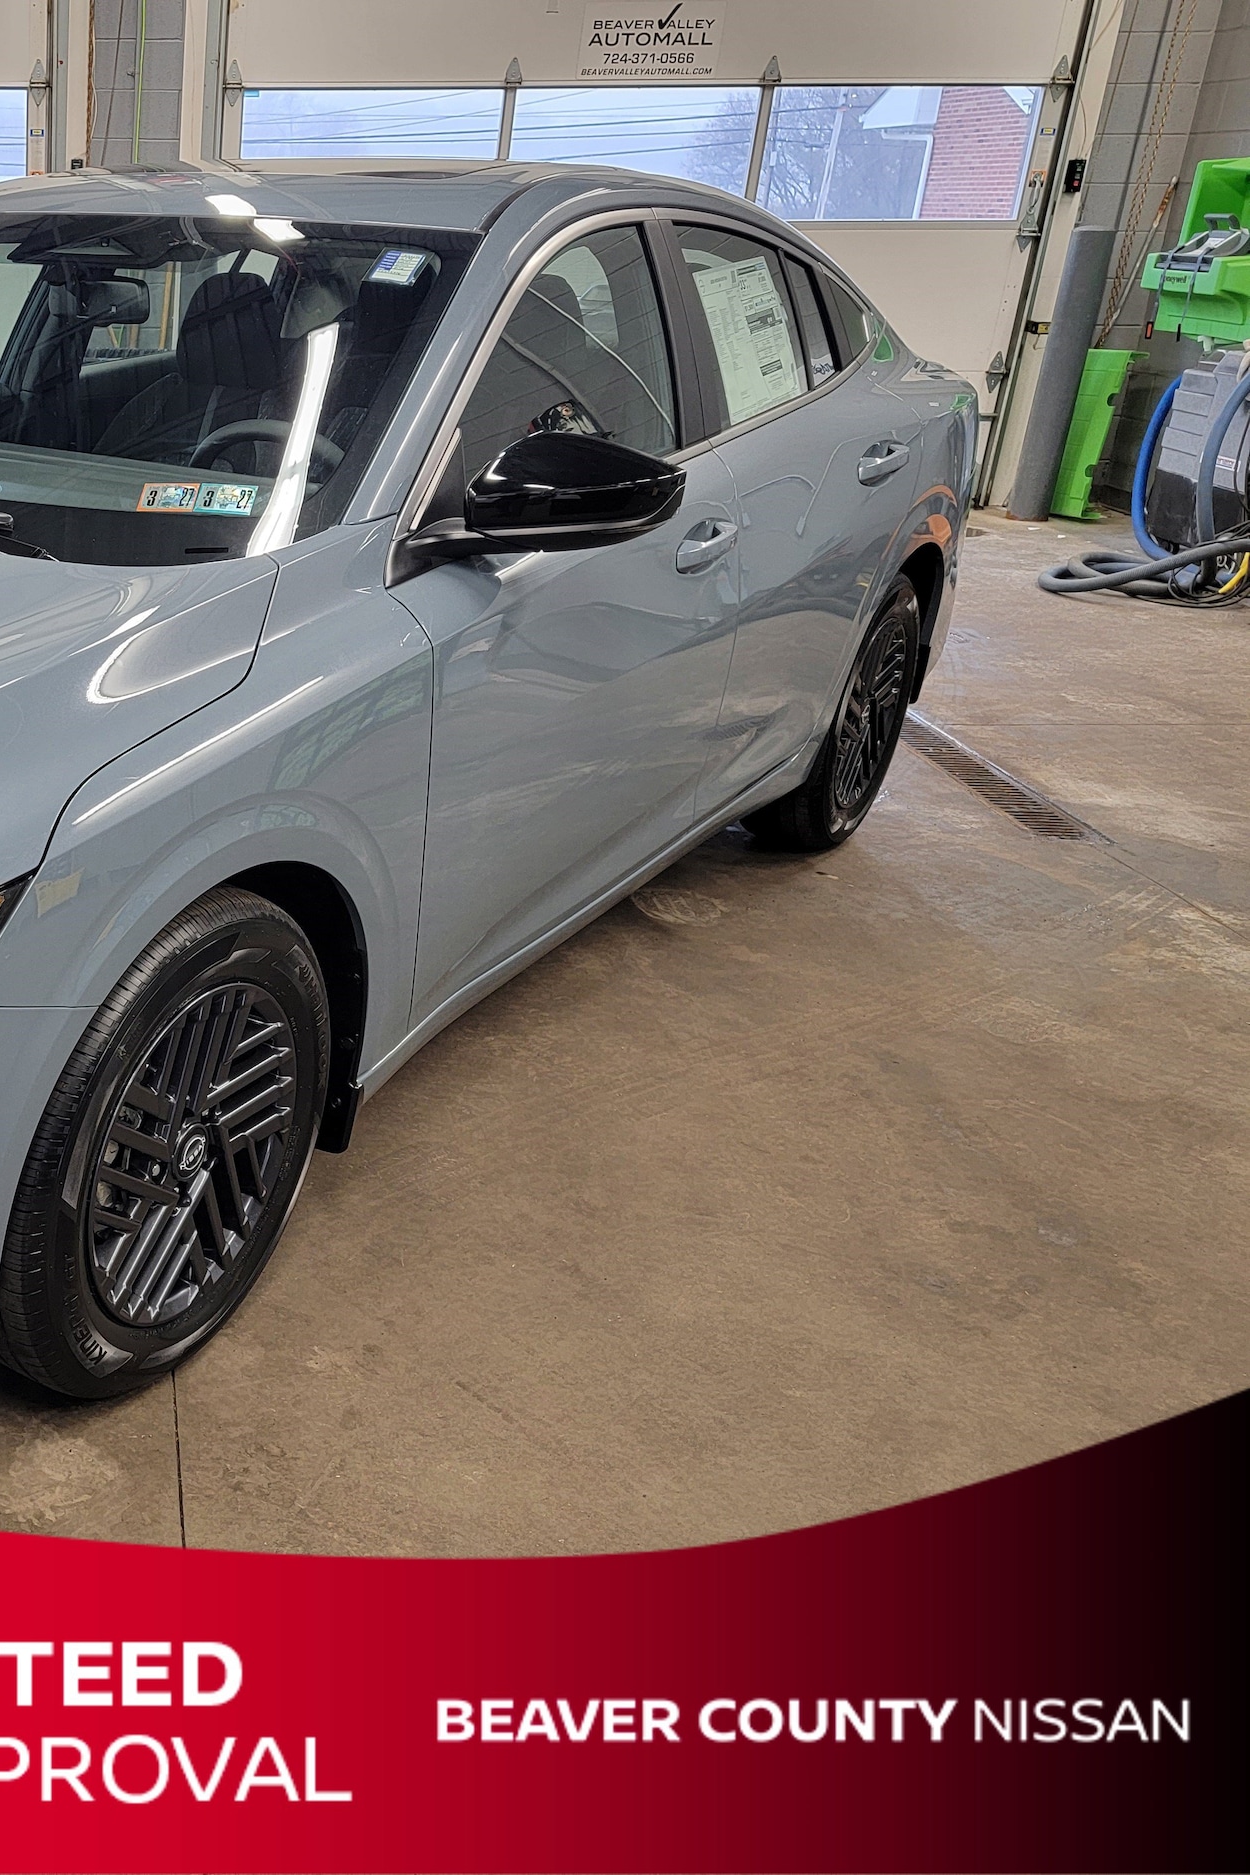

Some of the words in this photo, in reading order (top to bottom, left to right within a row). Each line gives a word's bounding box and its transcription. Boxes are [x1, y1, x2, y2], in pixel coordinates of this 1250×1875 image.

[593, 20, 654, 30] BEAVER
[588, 32, 713, 47] AUTOMALL
[602, 53, 695, 64] 724-371-0566
[581, 68, 713, 76] BEAVERVALLEYAUTOMALL.COM
[147, 490, 158, 507] 3
[178, 487, 195, 507] 27
[203, 490, 215, 507] 3
[236, 489, 253, 509] 27
